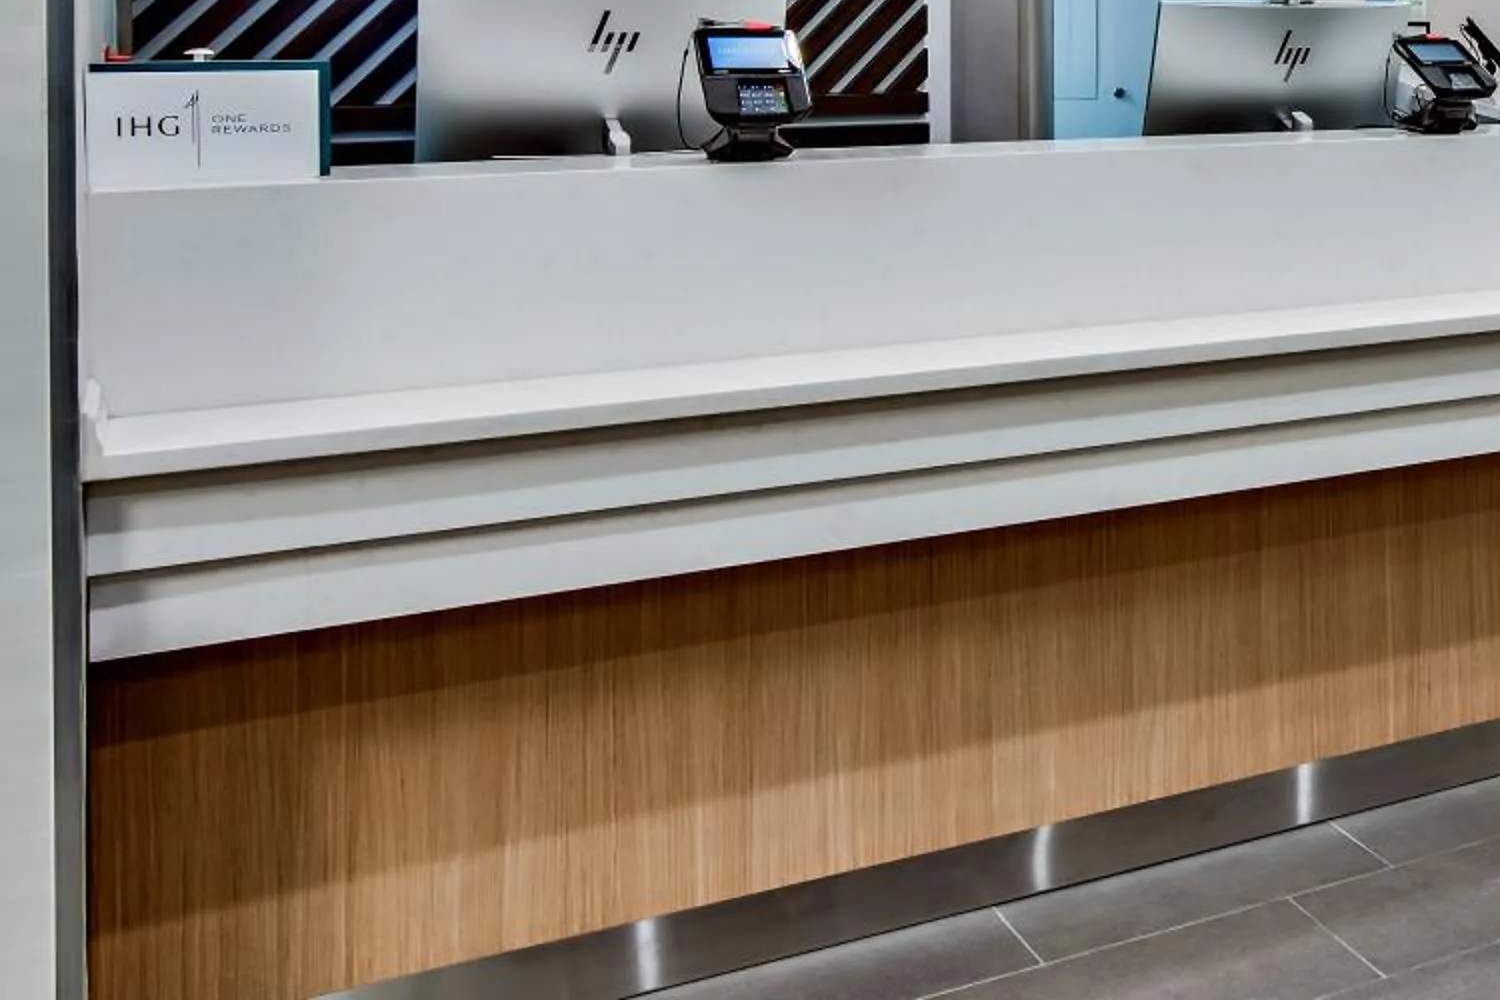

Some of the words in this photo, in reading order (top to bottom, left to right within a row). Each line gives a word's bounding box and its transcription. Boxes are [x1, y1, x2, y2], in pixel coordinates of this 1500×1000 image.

[587, 9, 641, 75] hp
[1274, 30, 1311, 83] hp
[116, 115, 181, 138] IHG
[211, 114, 248, 123] ONE
[211, 123, 292, 134] REWARDS
